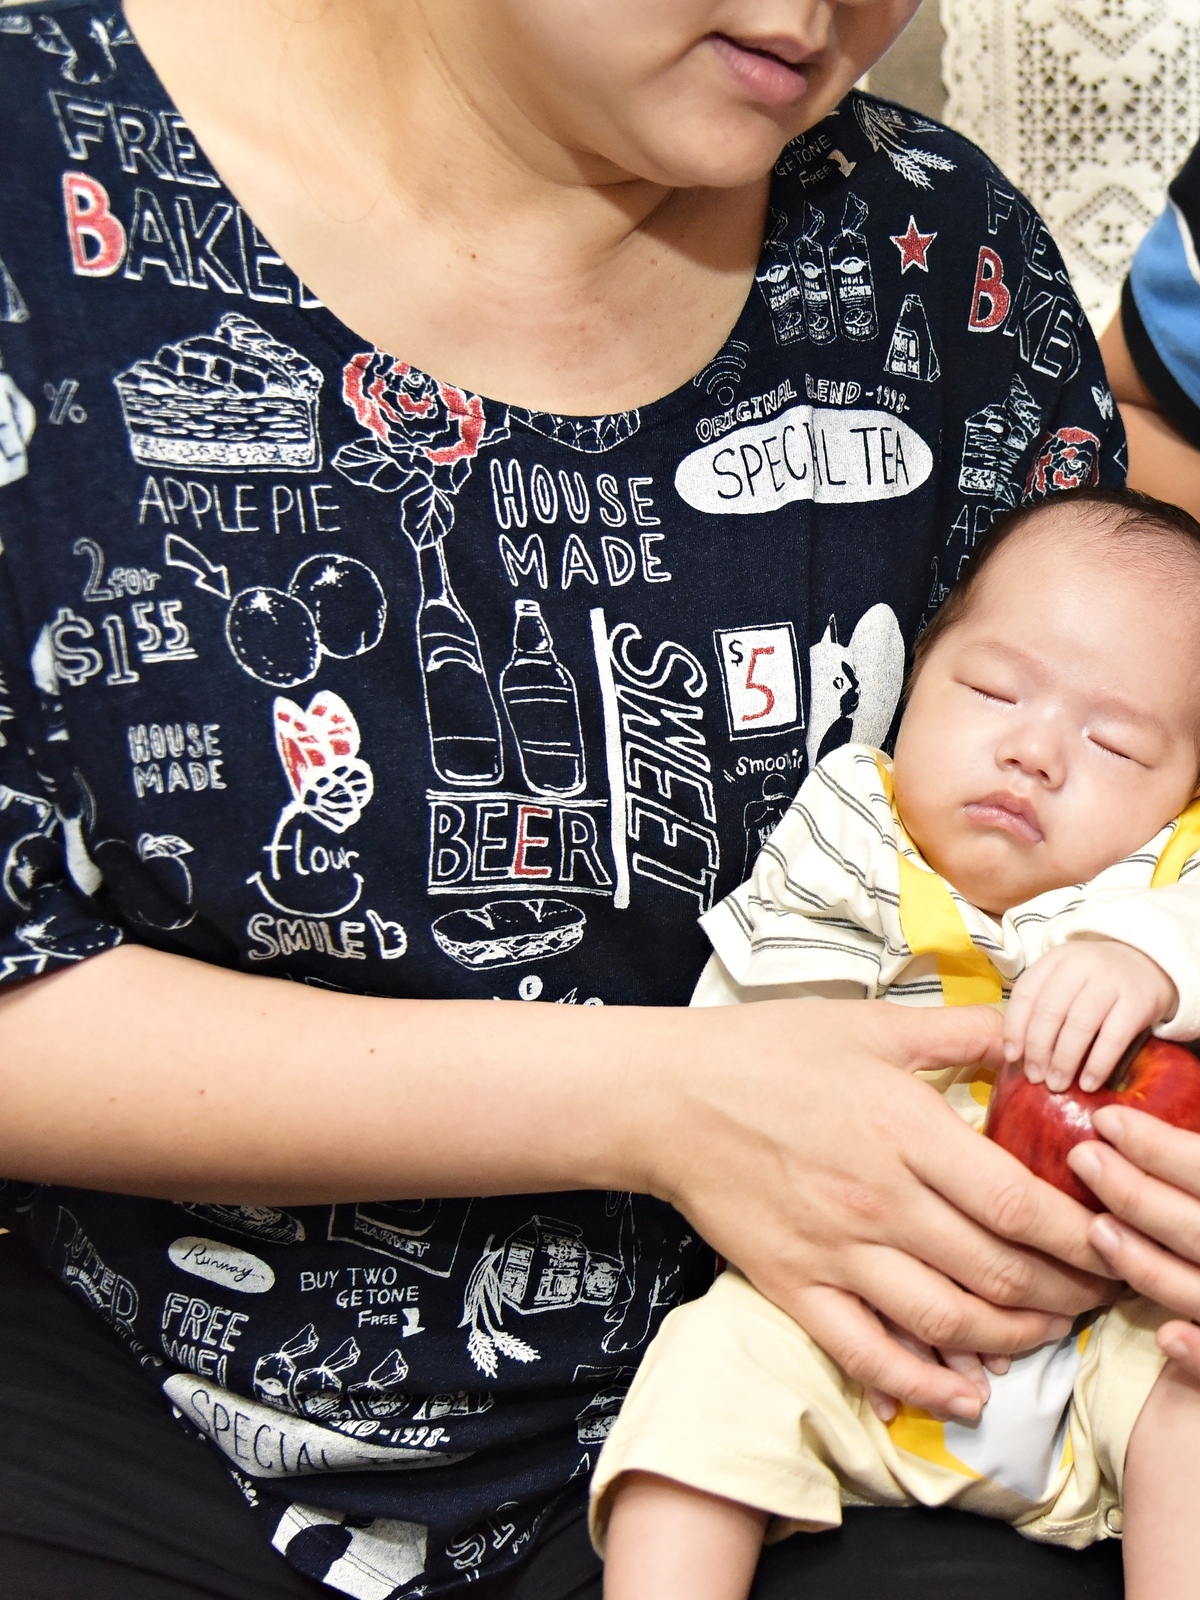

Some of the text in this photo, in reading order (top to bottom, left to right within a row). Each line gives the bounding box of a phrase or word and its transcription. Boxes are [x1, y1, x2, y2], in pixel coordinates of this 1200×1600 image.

[696, 379, 797, 443] ORIGINAL
[850, 426, 910, 486] TEA
[138, 475, 341, 534] APPLE PIE
[490, 458, 661, 529] HOUSE
[73, 537, 116, 602] 2
[499, 533, 672, 590] MADE
[127, 723, 223, 765] HOUSE
[609, 622, 720, 915] SWEET
[133, 760, 228, 799] MADE
[427, 801, 613, 887] BEER
[247, 912, 367, 960] SMILE
[354, 1219, 431, 1257] MARKET
[301, 1266, 397, 1292] BUY TWO
[162, 1292, 250, 1352] FREE
